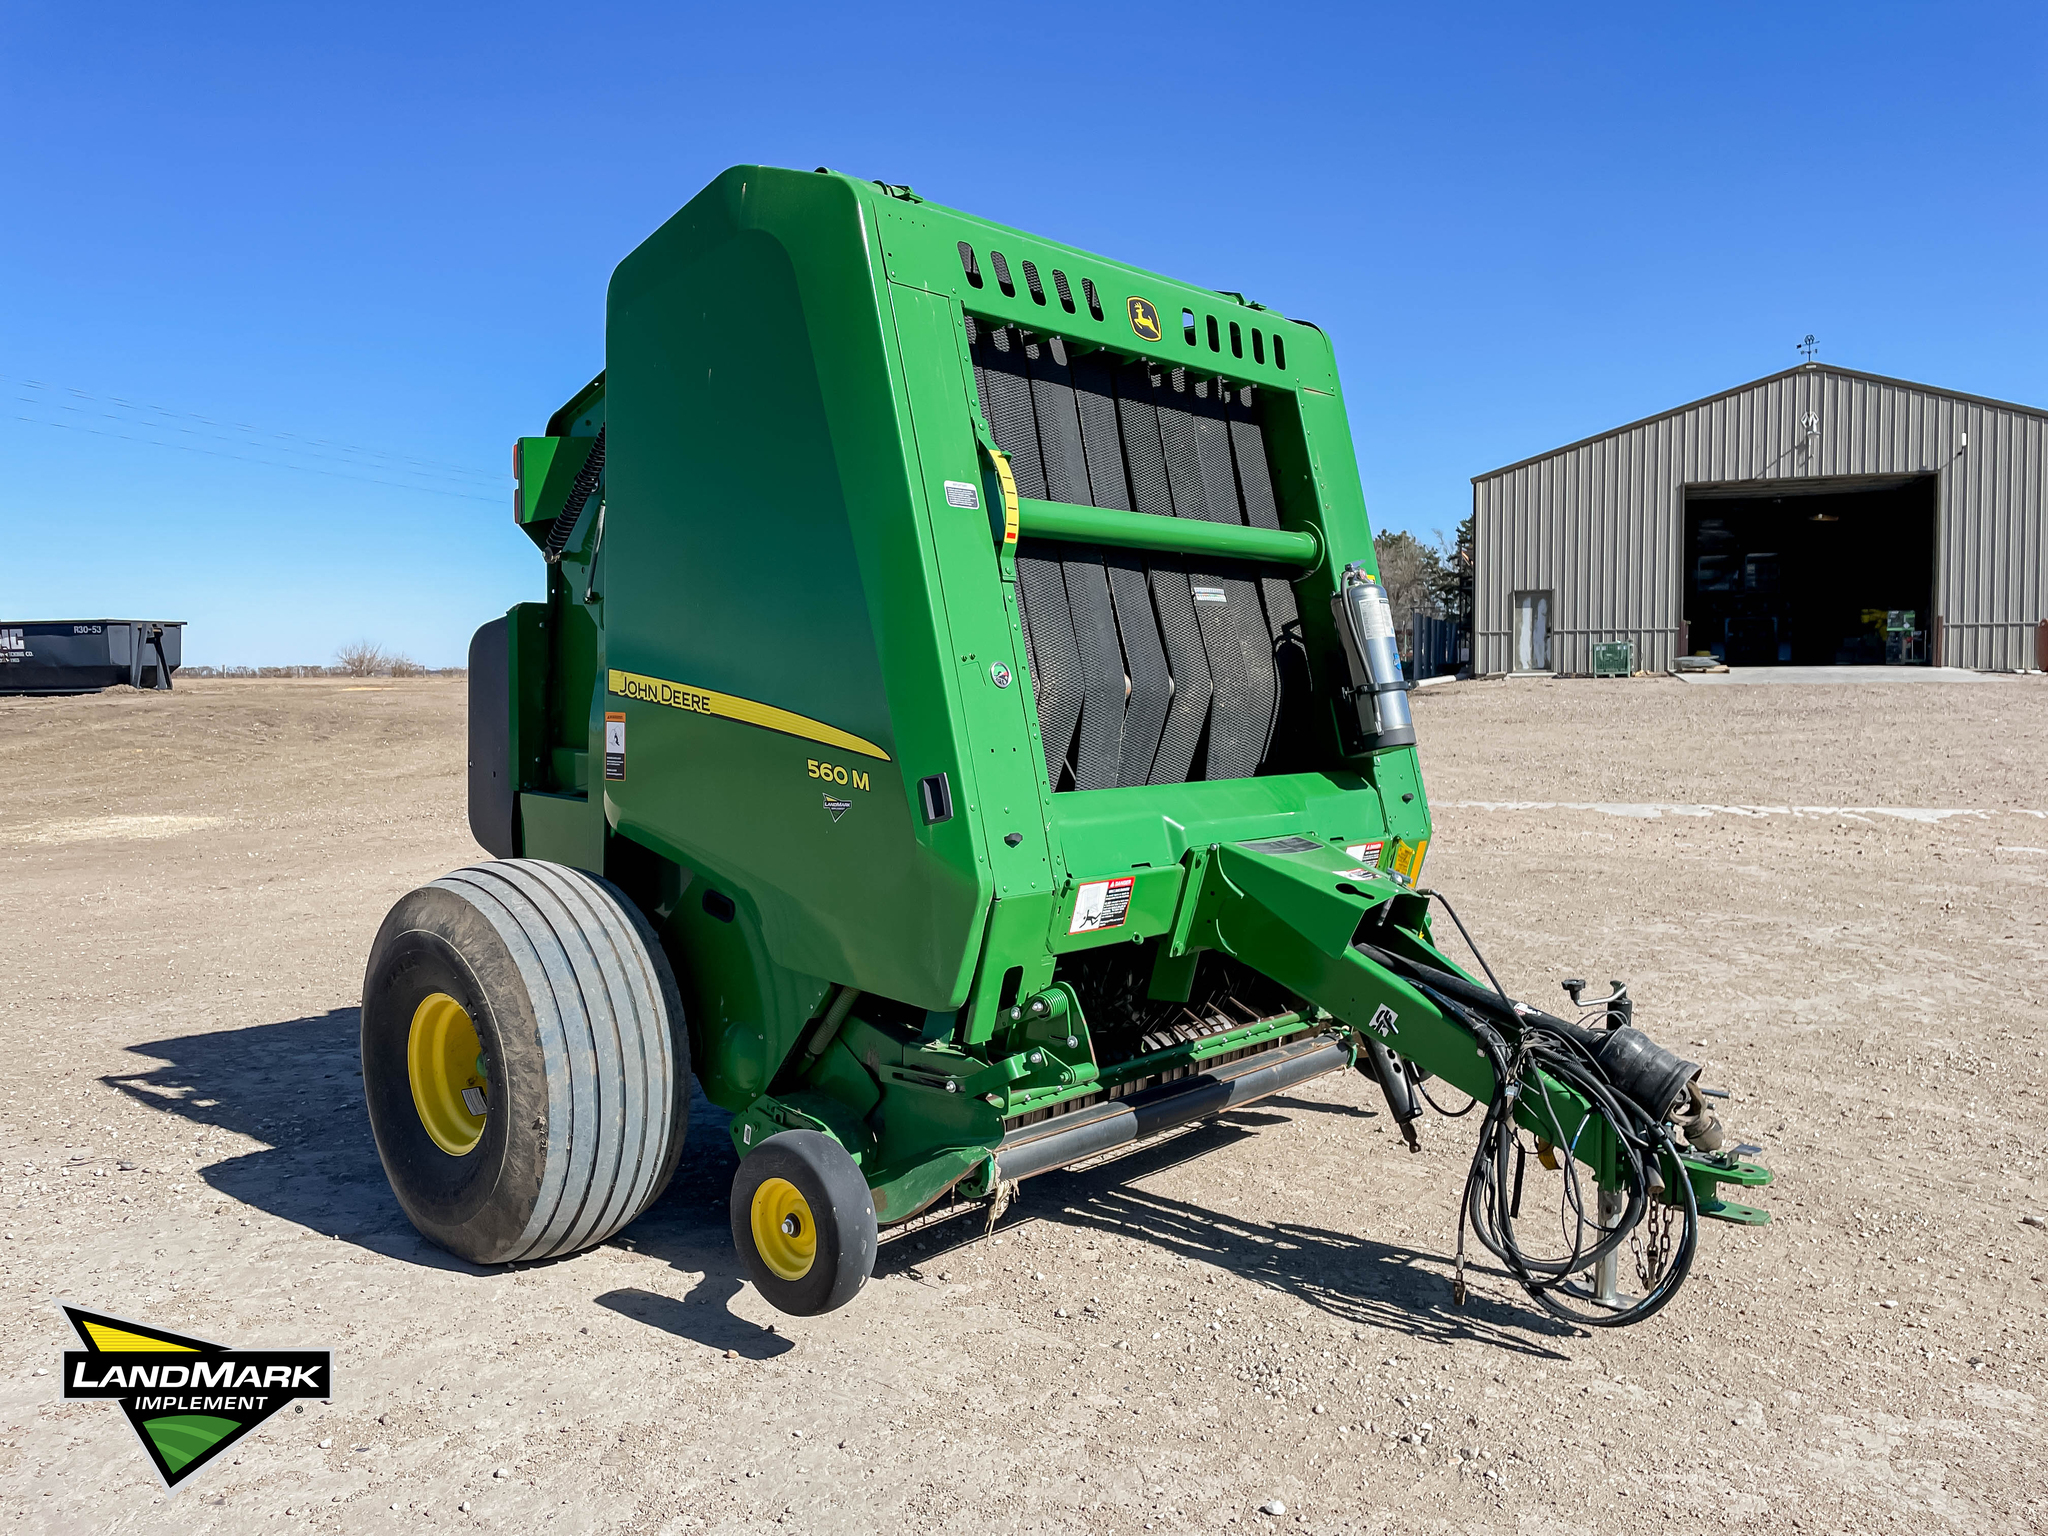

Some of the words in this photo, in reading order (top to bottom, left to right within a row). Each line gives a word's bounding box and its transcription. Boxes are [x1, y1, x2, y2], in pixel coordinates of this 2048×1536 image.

[74, 625, 102, 634] R30-53
[620, 676, 658, 700] JOHN
[661, 683, 711, 712] DEERE
[807, 758, 849, 786] 560
[851, 768, 870, 792] M
